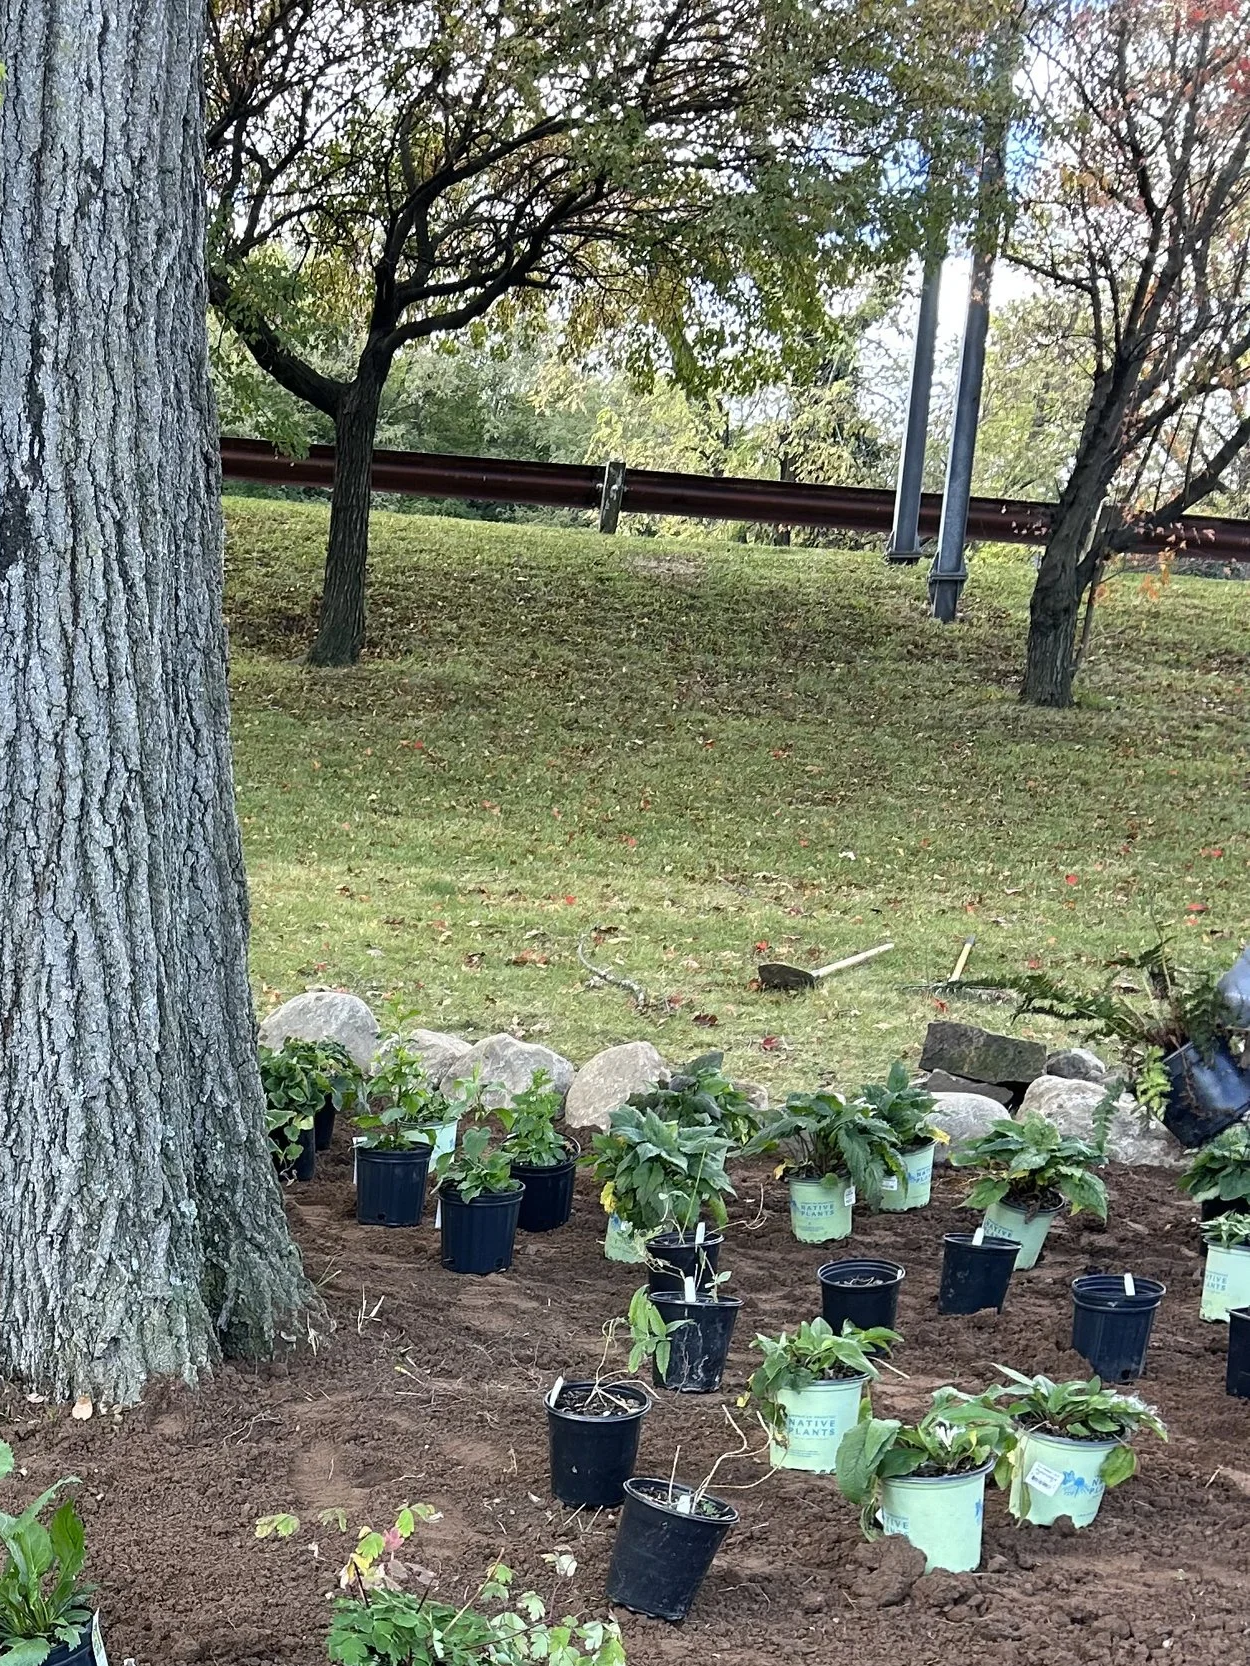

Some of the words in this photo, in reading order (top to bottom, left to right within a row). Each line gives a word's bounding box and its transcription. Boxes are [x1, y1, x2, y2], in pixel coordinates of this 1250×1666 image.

[788, 1418, 835, 1427] NATIVE
[788, 1427, 835, 1436] PLANTS
[886, 1517, 909, 1529] TIVE
